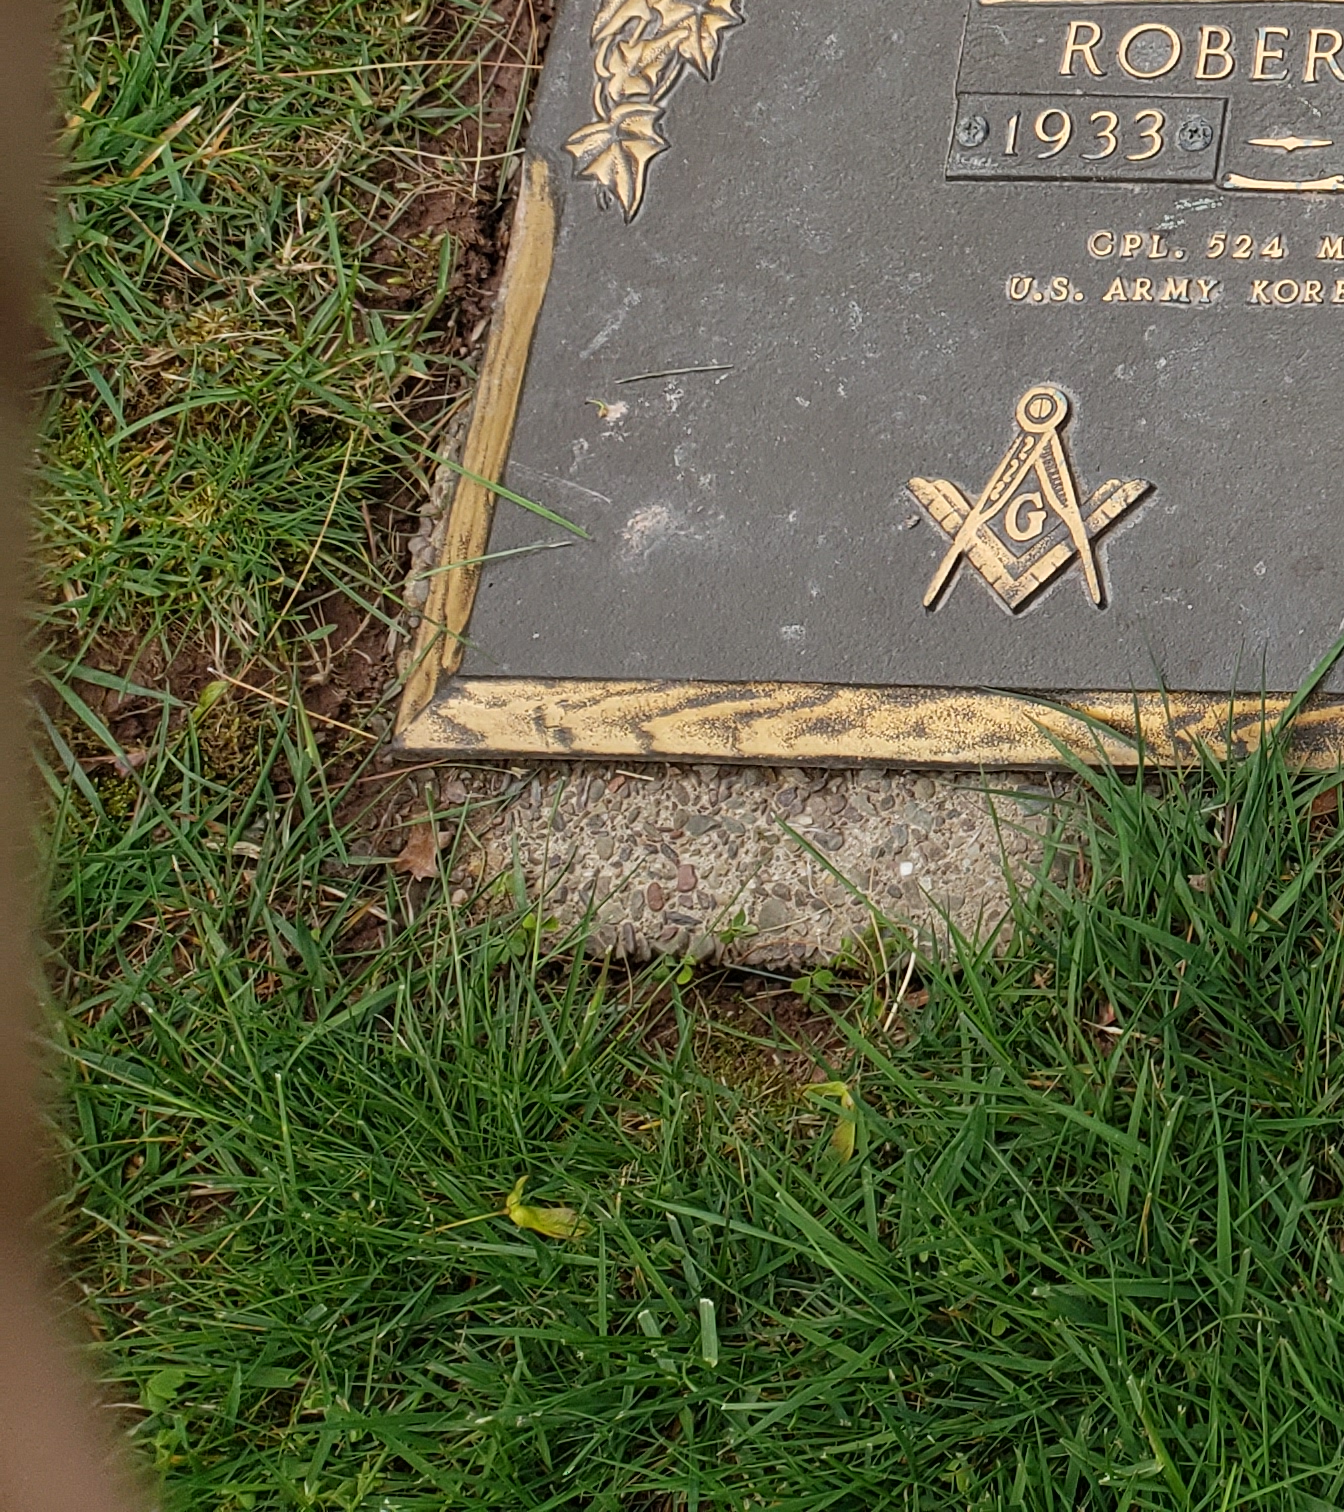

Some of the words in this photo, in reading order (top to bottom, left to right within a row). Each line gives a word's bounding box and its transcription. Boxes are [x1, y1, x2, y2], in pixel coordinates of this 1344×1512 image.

[1005, 107, 1167, 162] 1933
[1090, 231, 1185, 260] CPL.
[1206, 233, 1285, 260] 524
[1009, 276, 1085, 302] U.S.
[1102, 276, 1220, 304] ARMY
